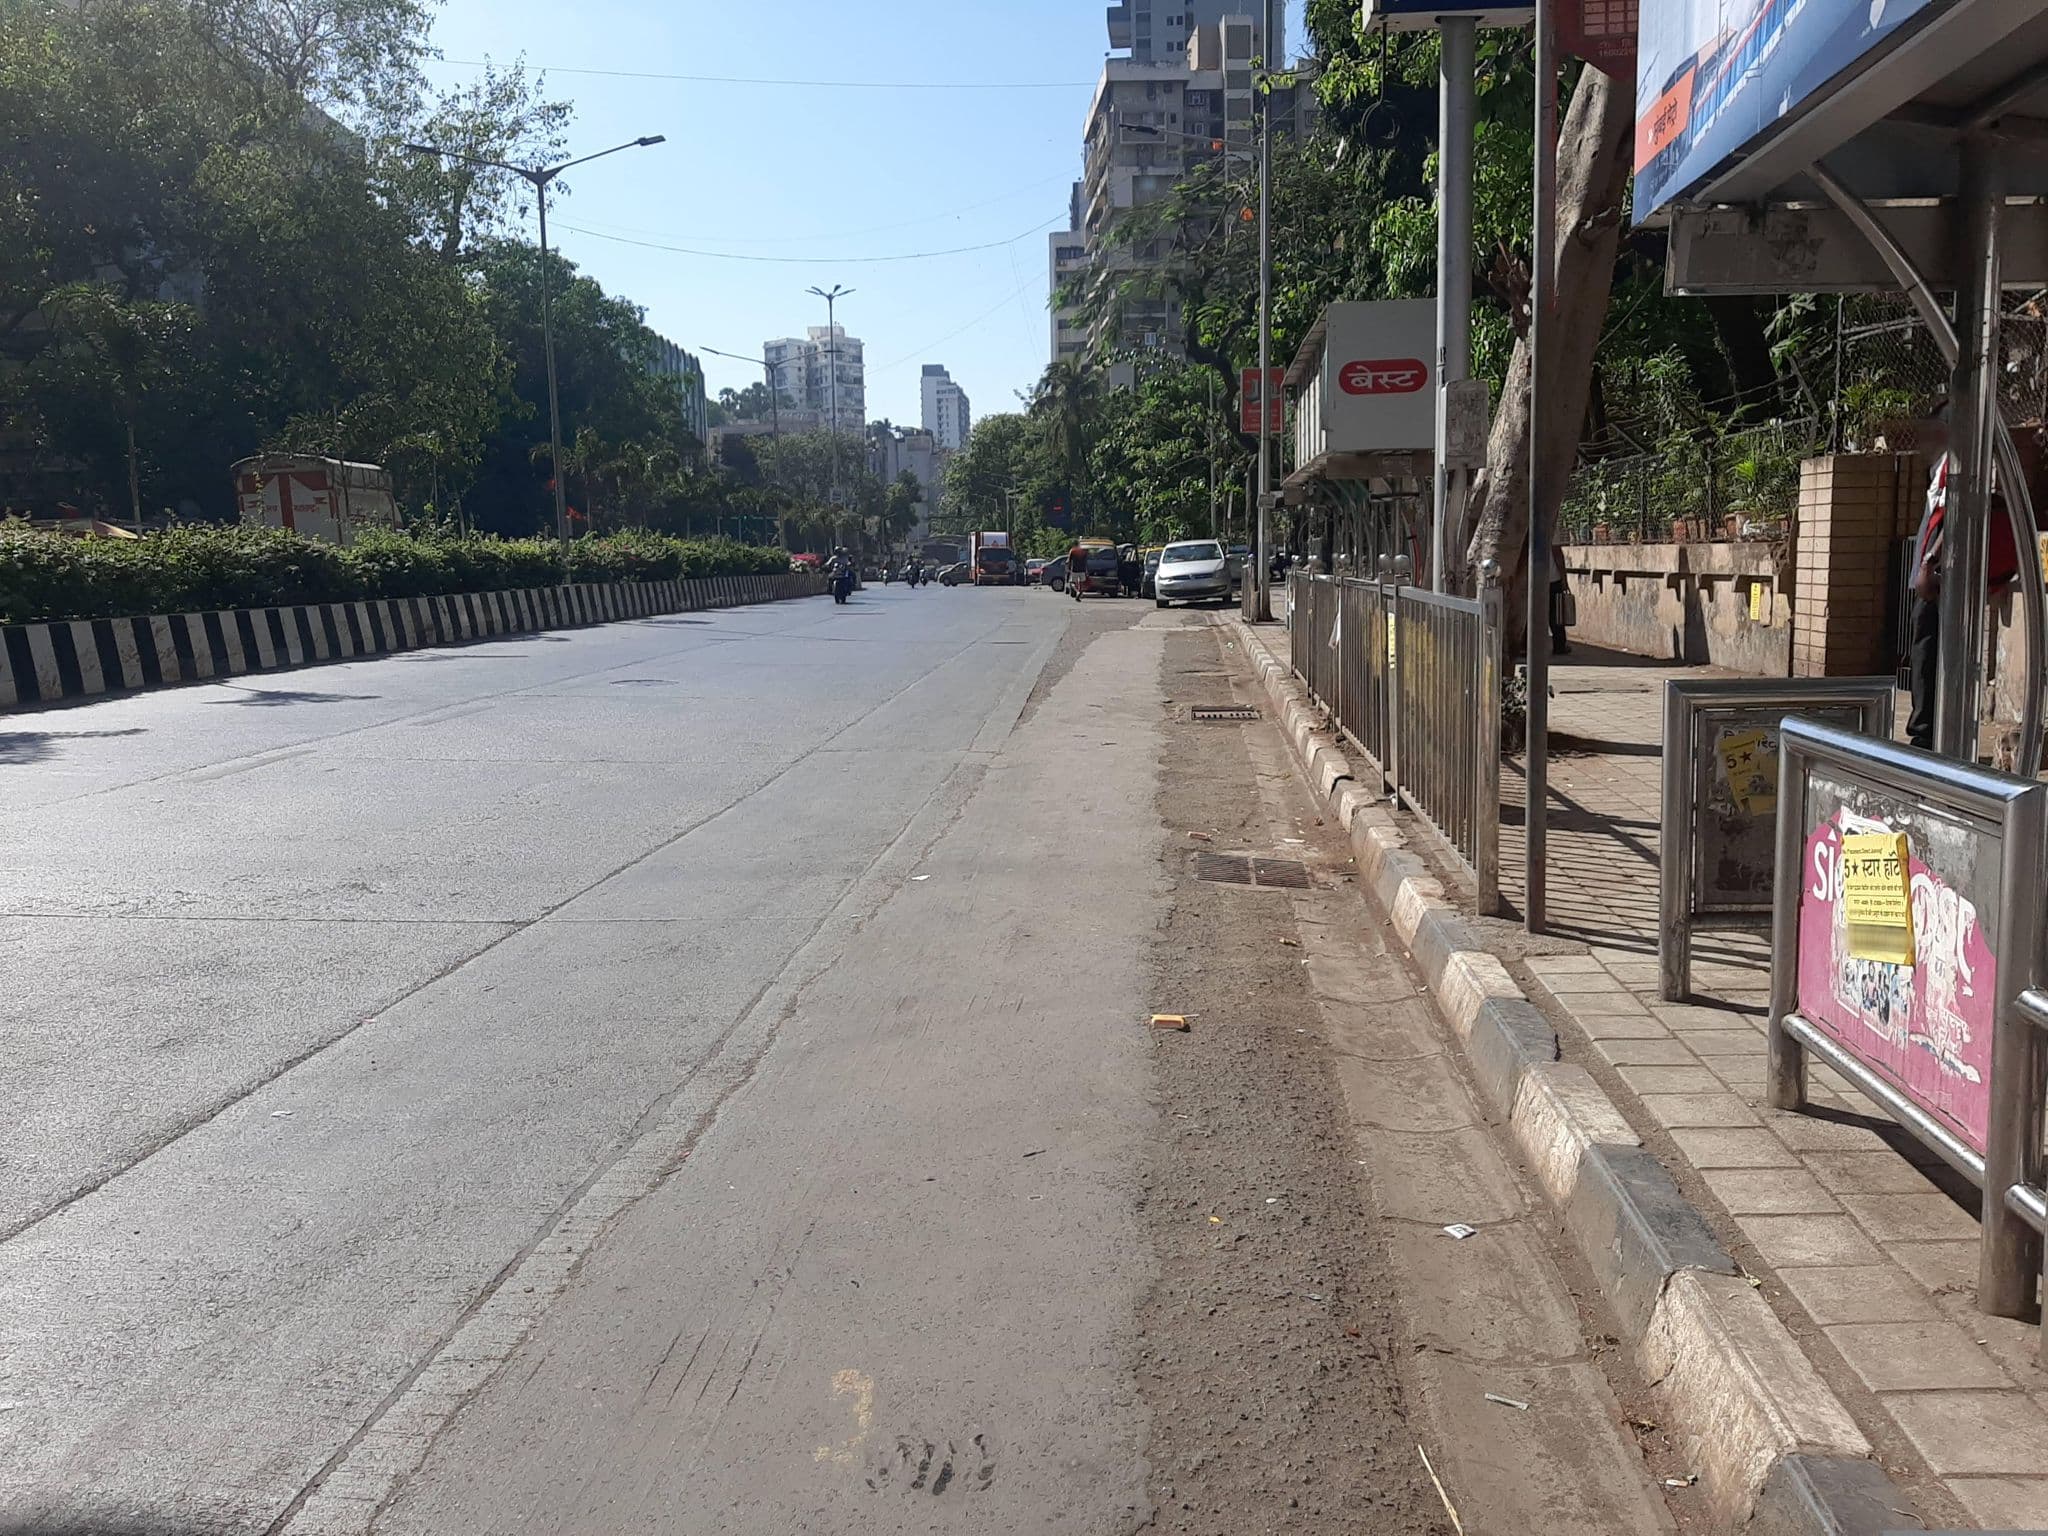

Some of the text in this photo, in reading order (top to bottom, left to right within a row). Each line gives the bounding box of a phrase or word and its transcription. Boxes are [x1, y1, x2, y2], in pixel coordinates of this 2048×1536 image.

[1347, 364, 1419, 390] बेस्ट
[1844, 849, 1901, 880] 5 स्टार हॉटे
